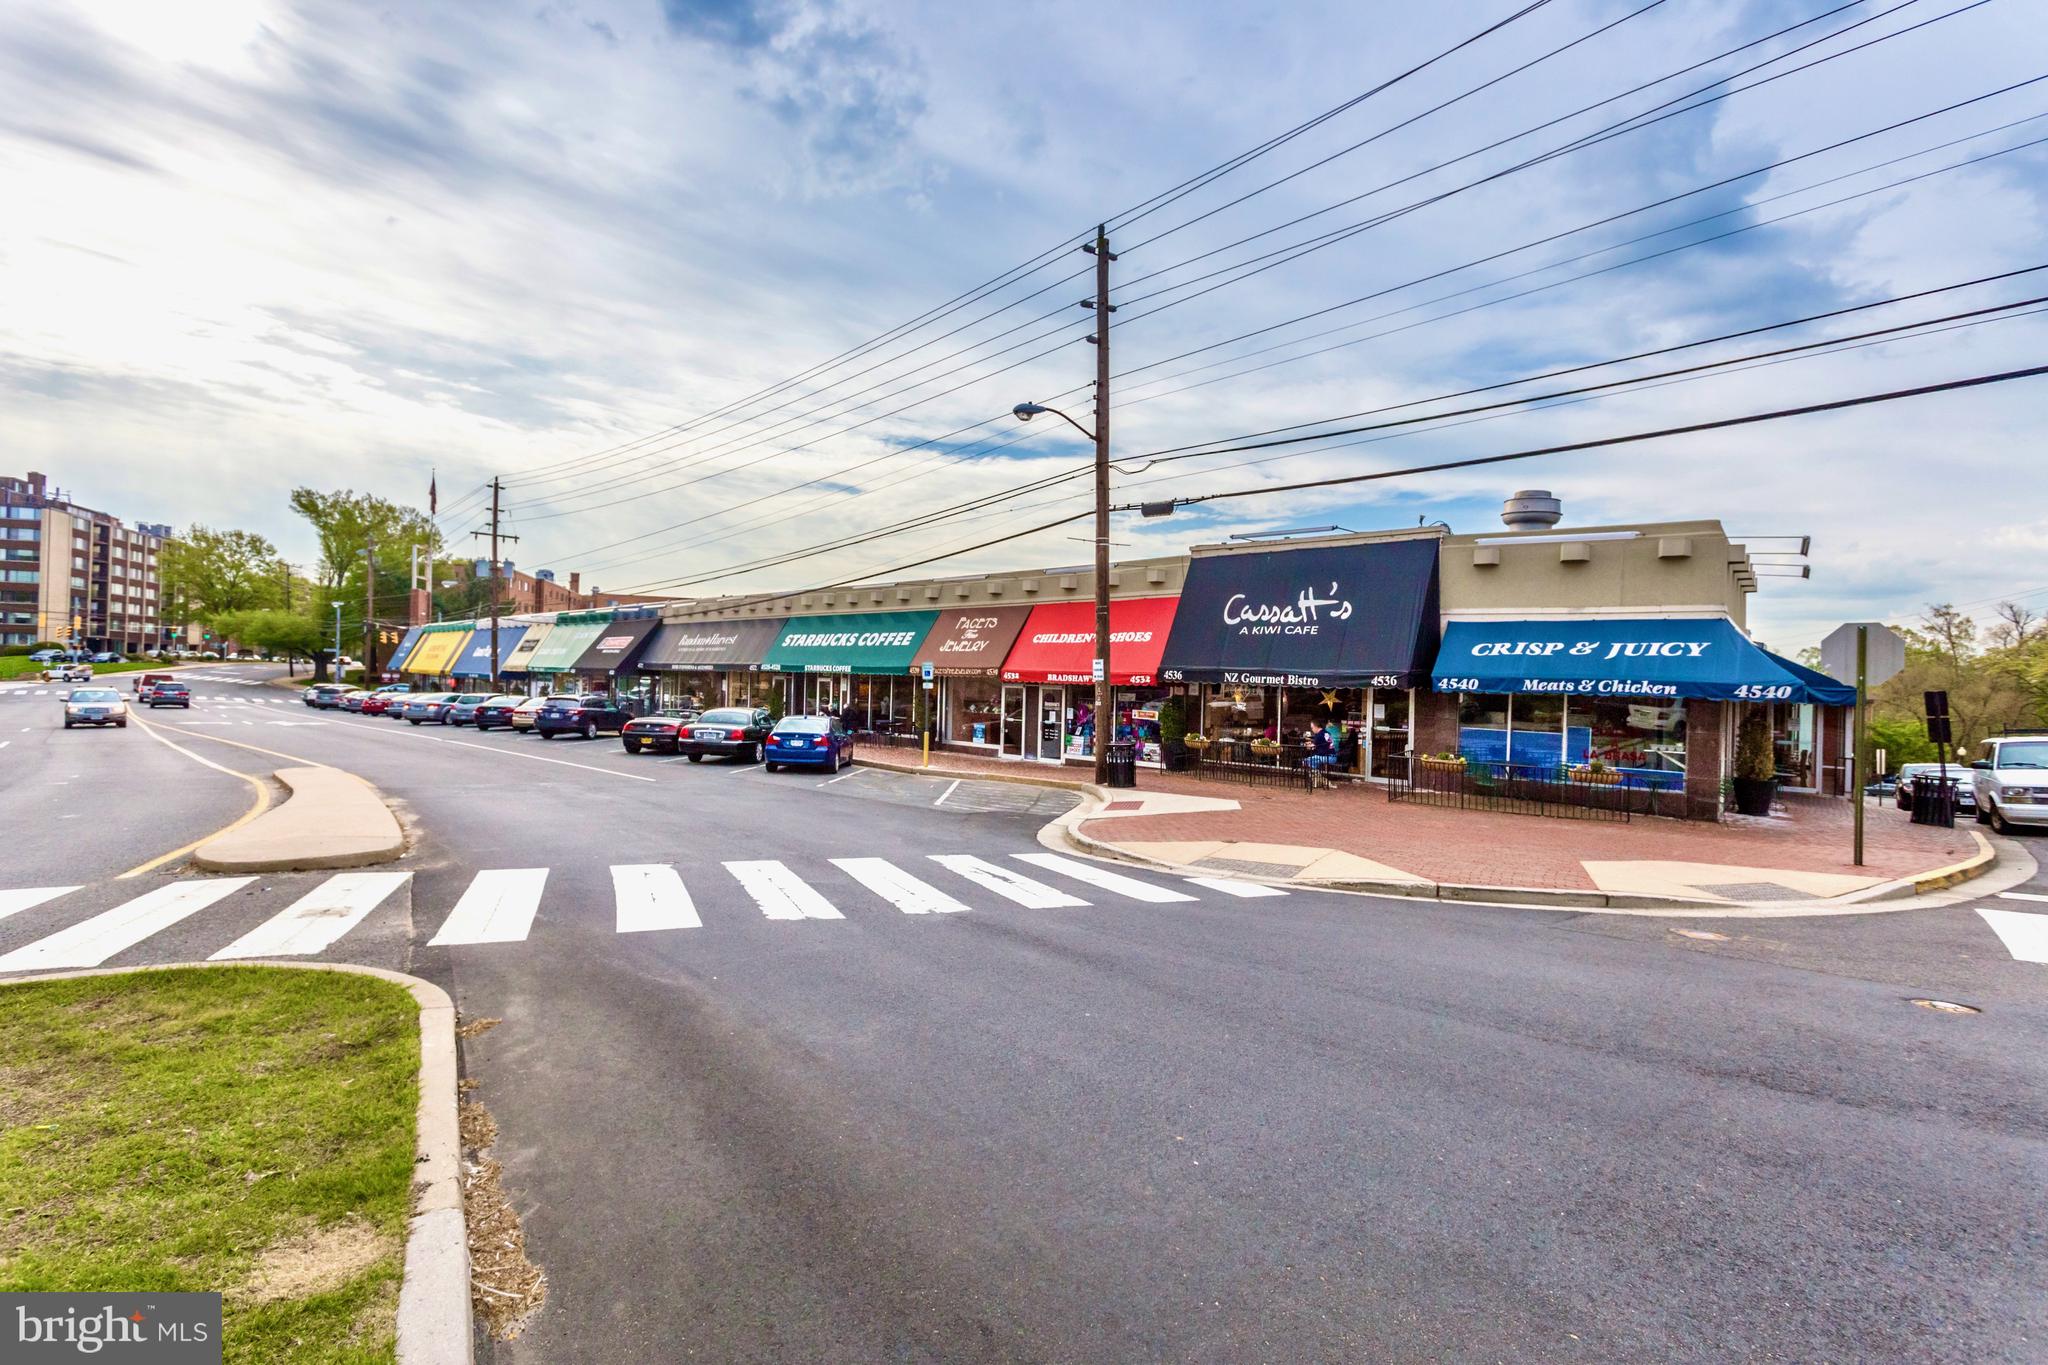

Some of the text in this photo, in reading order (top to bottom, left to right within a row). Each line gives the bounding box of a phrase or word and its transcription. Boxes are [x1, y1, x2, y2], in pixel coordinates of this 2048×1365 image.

[1223, 581, 1353, 625] Cassatt's
[955, 617, 998, 629] FACETS
[1238, 625, 1319, 635] A KIWI CAFE
[781, 631, 916, 647] STARBUCKS COFFEE
[1109, 631, 1153, 643] SHOES
[939, 639, 990, 652] JEWELRY
[1471, 641, 1712, 660] CRISP & JUICY
[804, 664, 851, 673] STARBUCKS COFFEE
[1129, 675, 1151, 684] 4532
[1163, 670, 1183, 680] 4536
[1224, 672, 1319, 686] NZ Gourmet Bistro
[1371, 675, 1398, 687] 4536
[1438, 678, 1479, 690] 4540
[1522, 679, 1678, 695] Meats & Chicken
[1733, 684, 1793, 699] 4540
